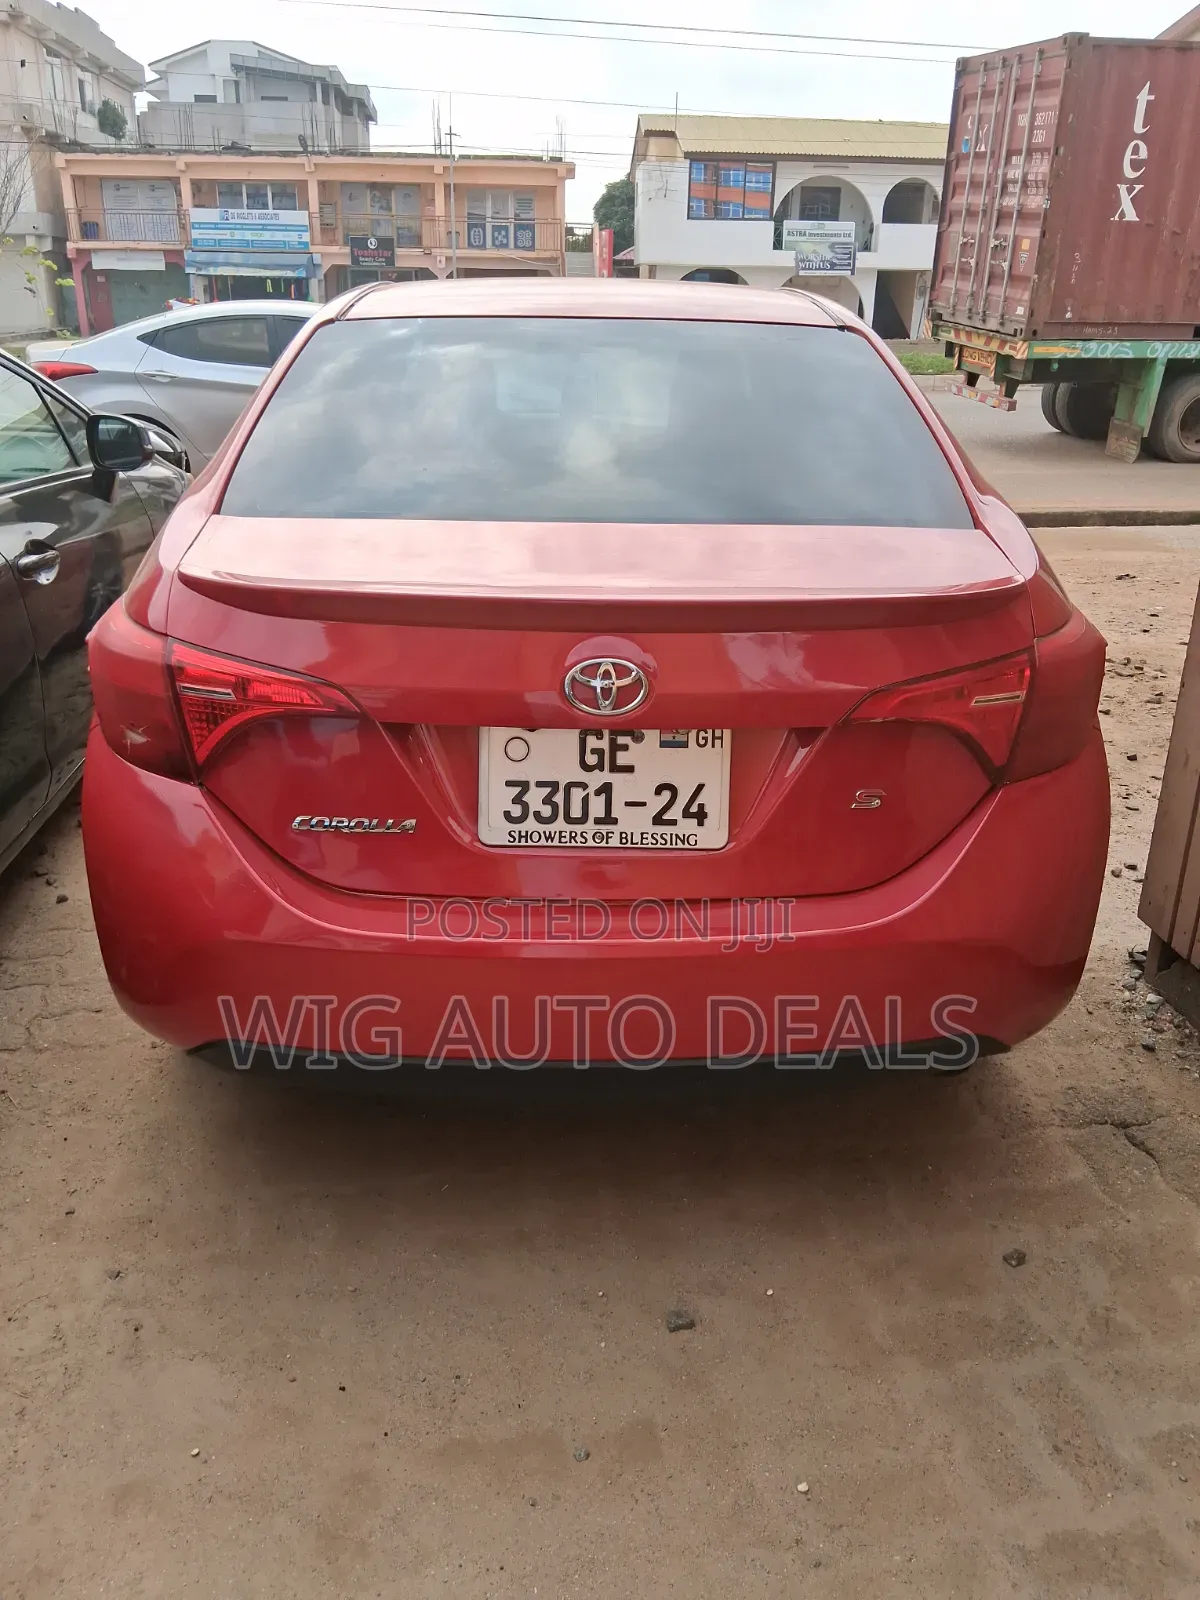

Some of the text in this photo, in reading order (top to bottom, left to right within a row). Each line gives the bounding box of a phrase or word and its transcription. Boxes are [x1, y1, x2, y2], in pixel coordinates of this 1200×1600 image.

[1110, 80, 1155, 221] tex
[820, 261, 831, 270] US
[962, 348, 977, 361] LONG
[695, 728, 723, 749] GH
[579, 728, 635, 773] GE
[503, 780, 708, 826] 3301-24
[850, 788, 887, 809] S
[291, 815, 417, 834] COROLLA
[508, 830, 698, 847] SHOWERS OF BLESSING
